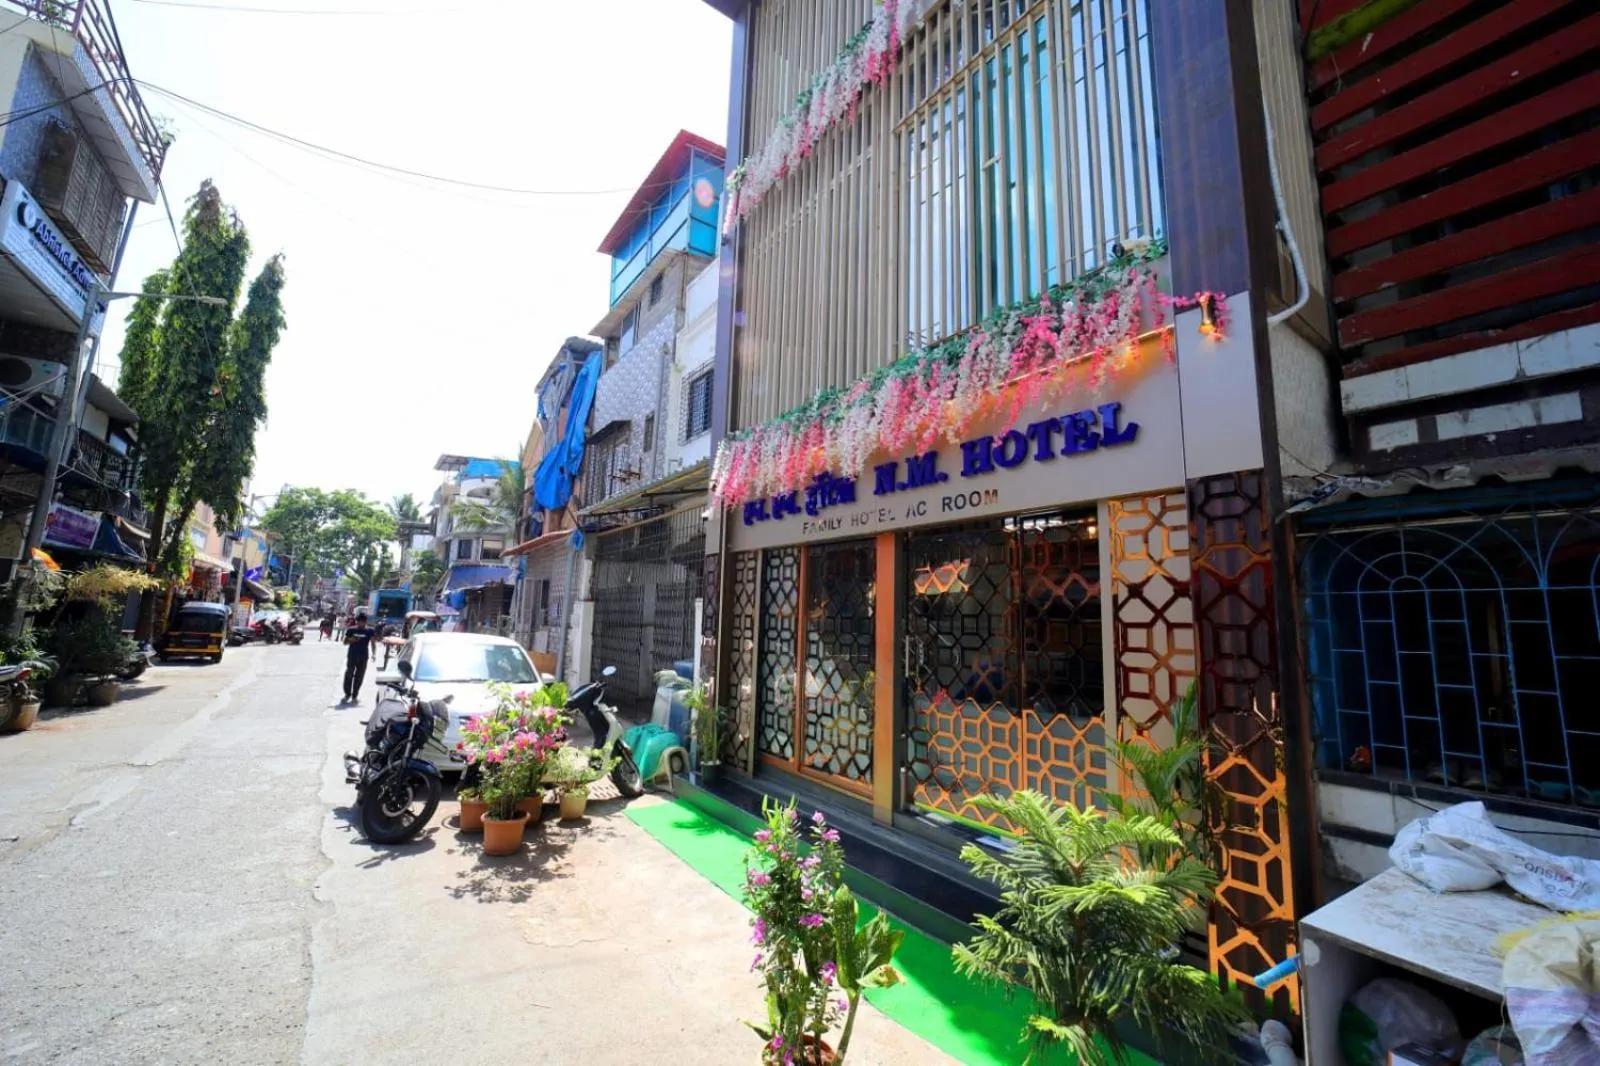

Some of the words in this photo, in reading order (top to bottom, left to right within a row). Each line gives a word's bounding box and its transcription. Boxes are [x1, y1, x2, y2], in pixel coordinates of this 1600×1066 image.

[874, 450, 948, 495] N.M.
[960, 402, 1139, 477] HOTEL
[803, 516, 843, 534] FAMILY
[906, 501, 927, 518] AC
[942, 489, 999, 513] ROOM
